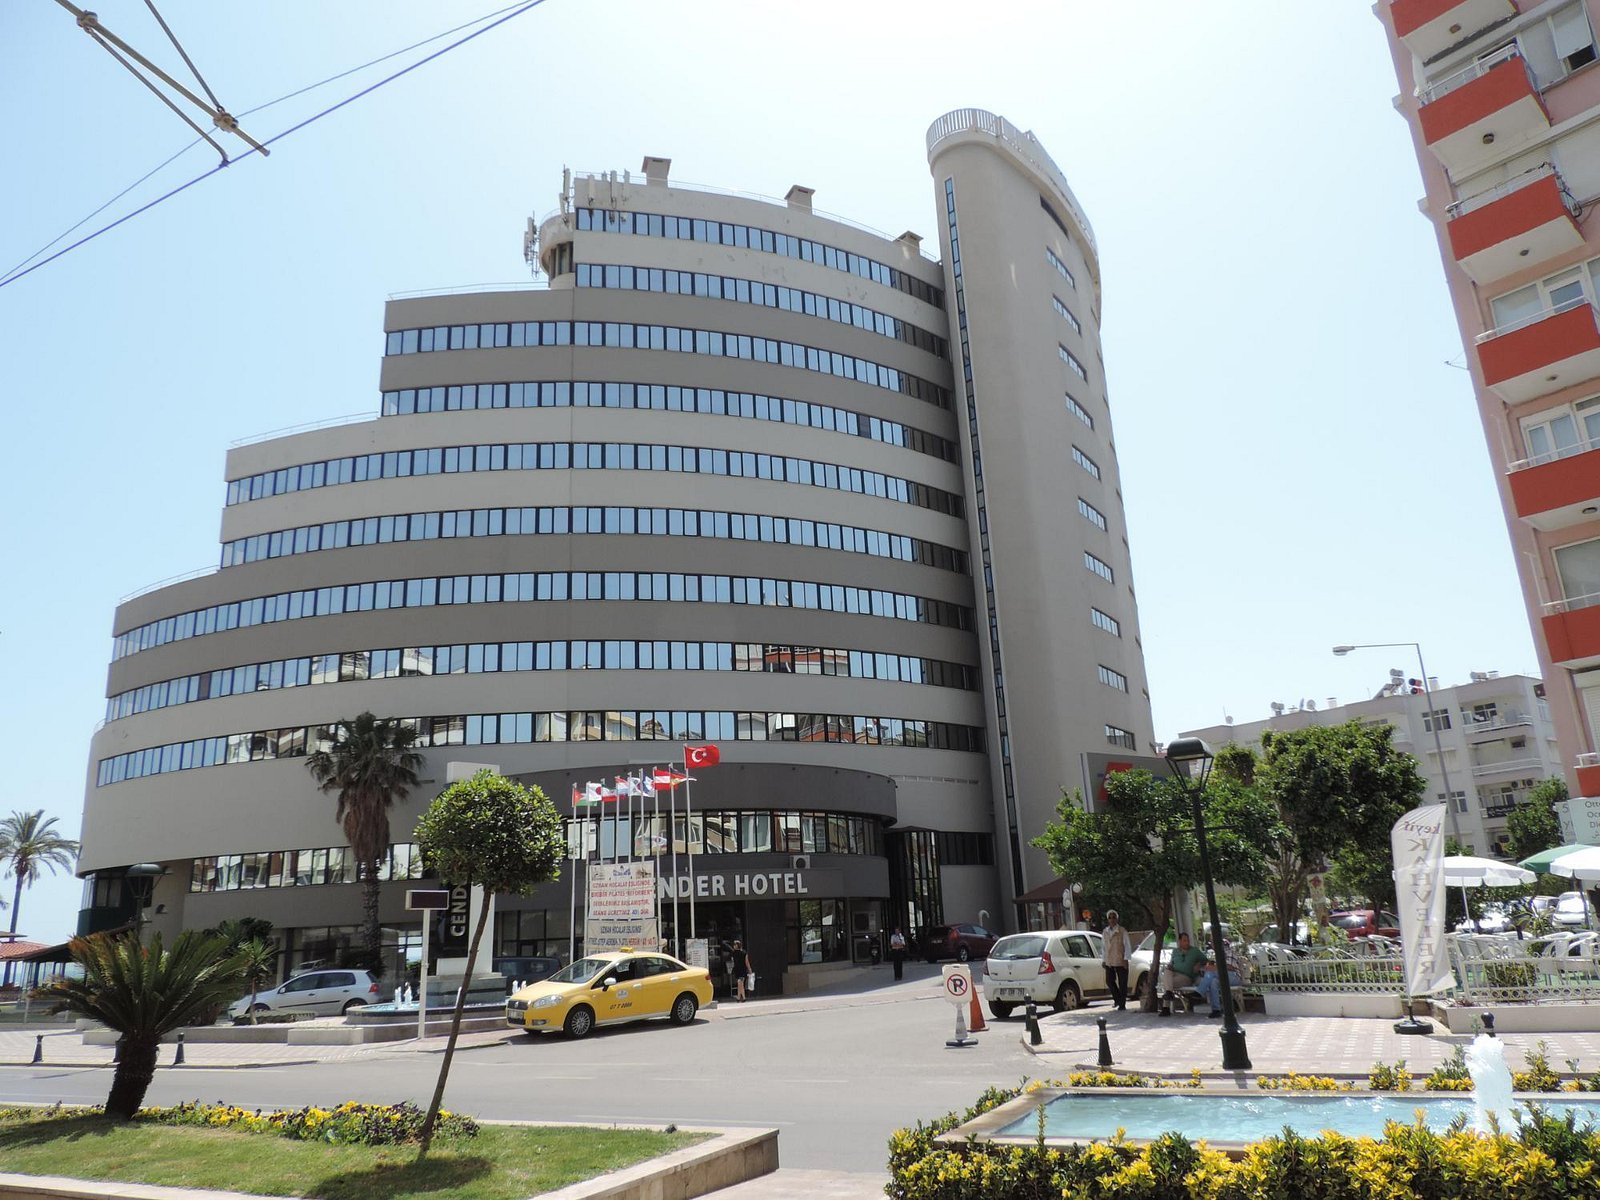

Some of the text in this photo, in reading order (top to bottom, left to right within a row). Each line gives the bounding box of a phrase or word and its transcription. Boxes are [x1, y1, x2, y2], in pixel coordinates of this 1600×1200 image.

[656, 873, 808, 899] NDER HOTEL
[450, 884, 467, 937] CEND
